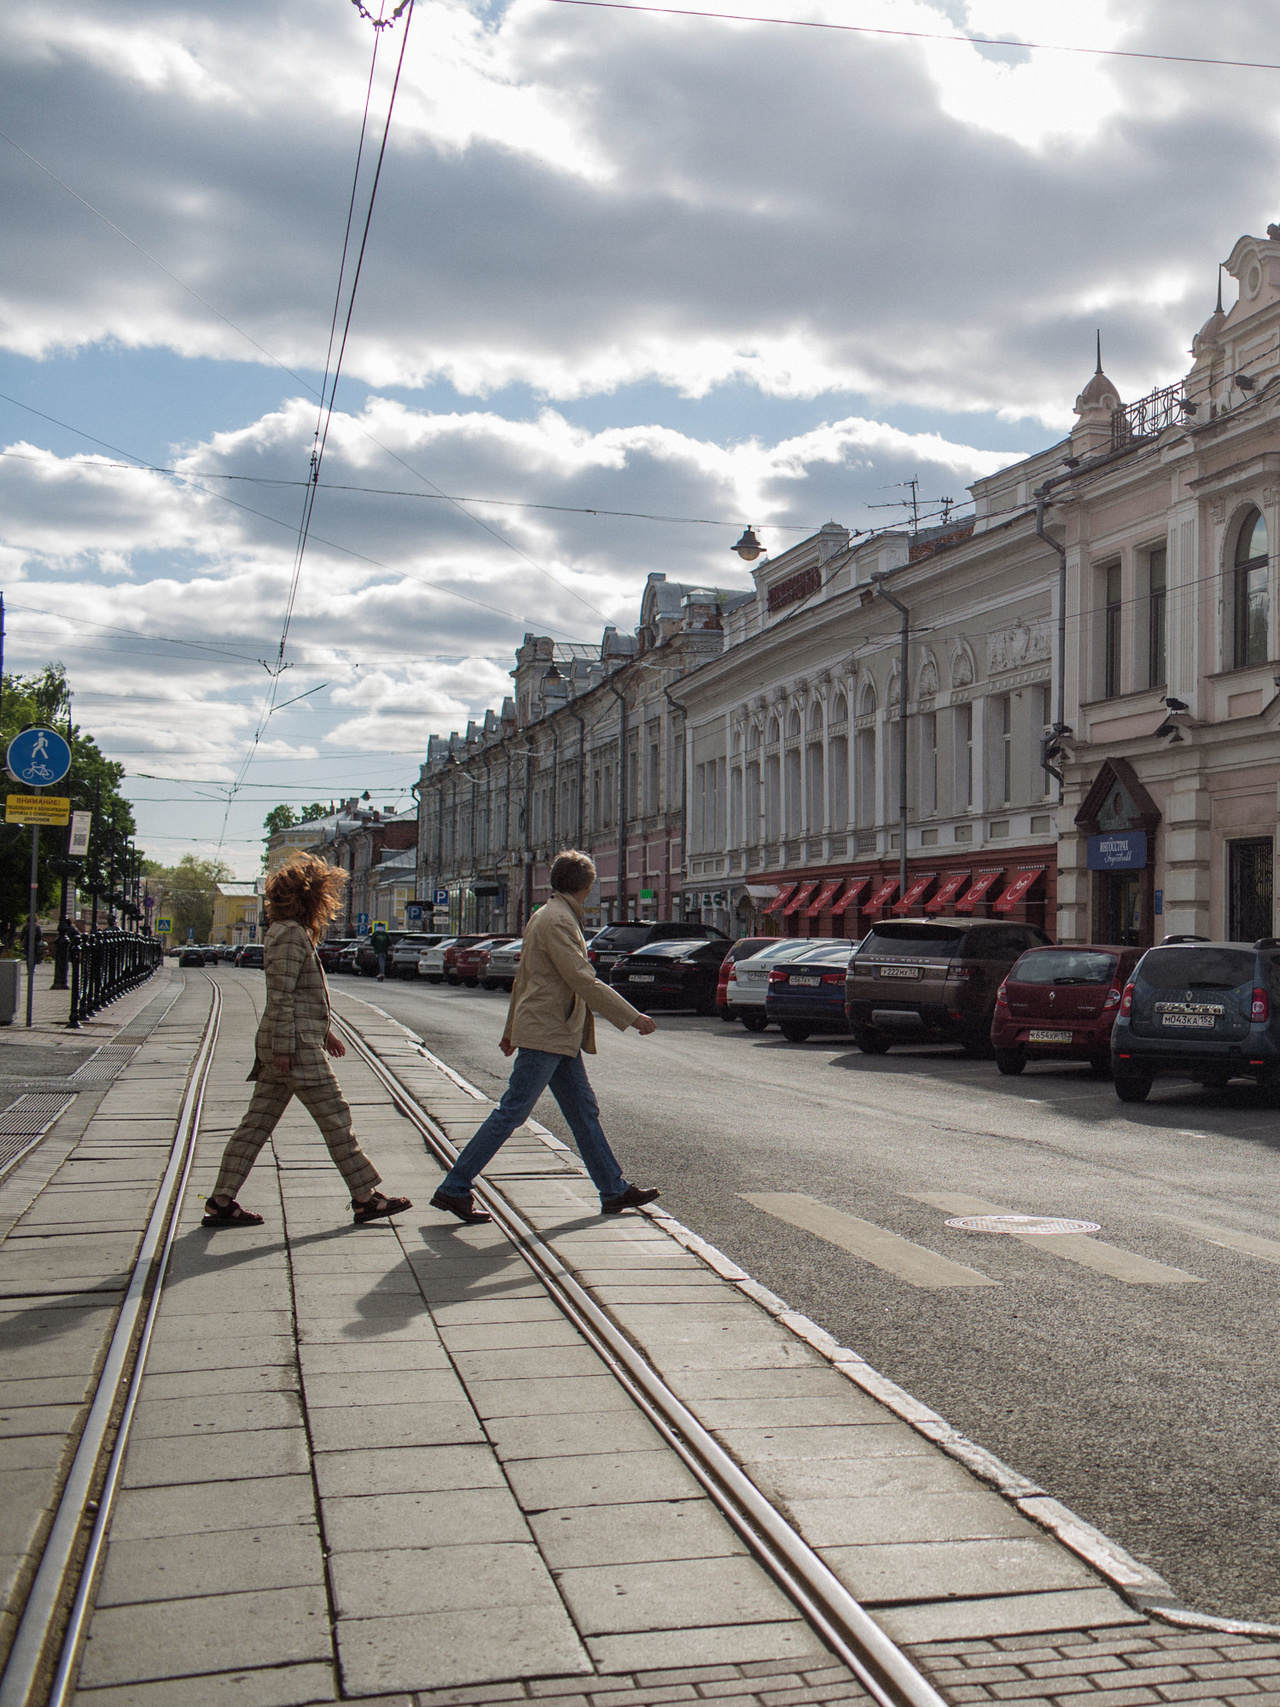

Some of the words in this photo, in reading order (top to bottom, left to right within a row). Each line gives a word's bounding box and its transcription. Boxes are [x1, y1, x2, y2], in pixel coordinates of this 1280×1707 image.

[16, 798, 61, 806] ВНИМАНИЕ!
[437, 891, 446, 903] P
[1165, 1015, 1198, 1025] М043КА
